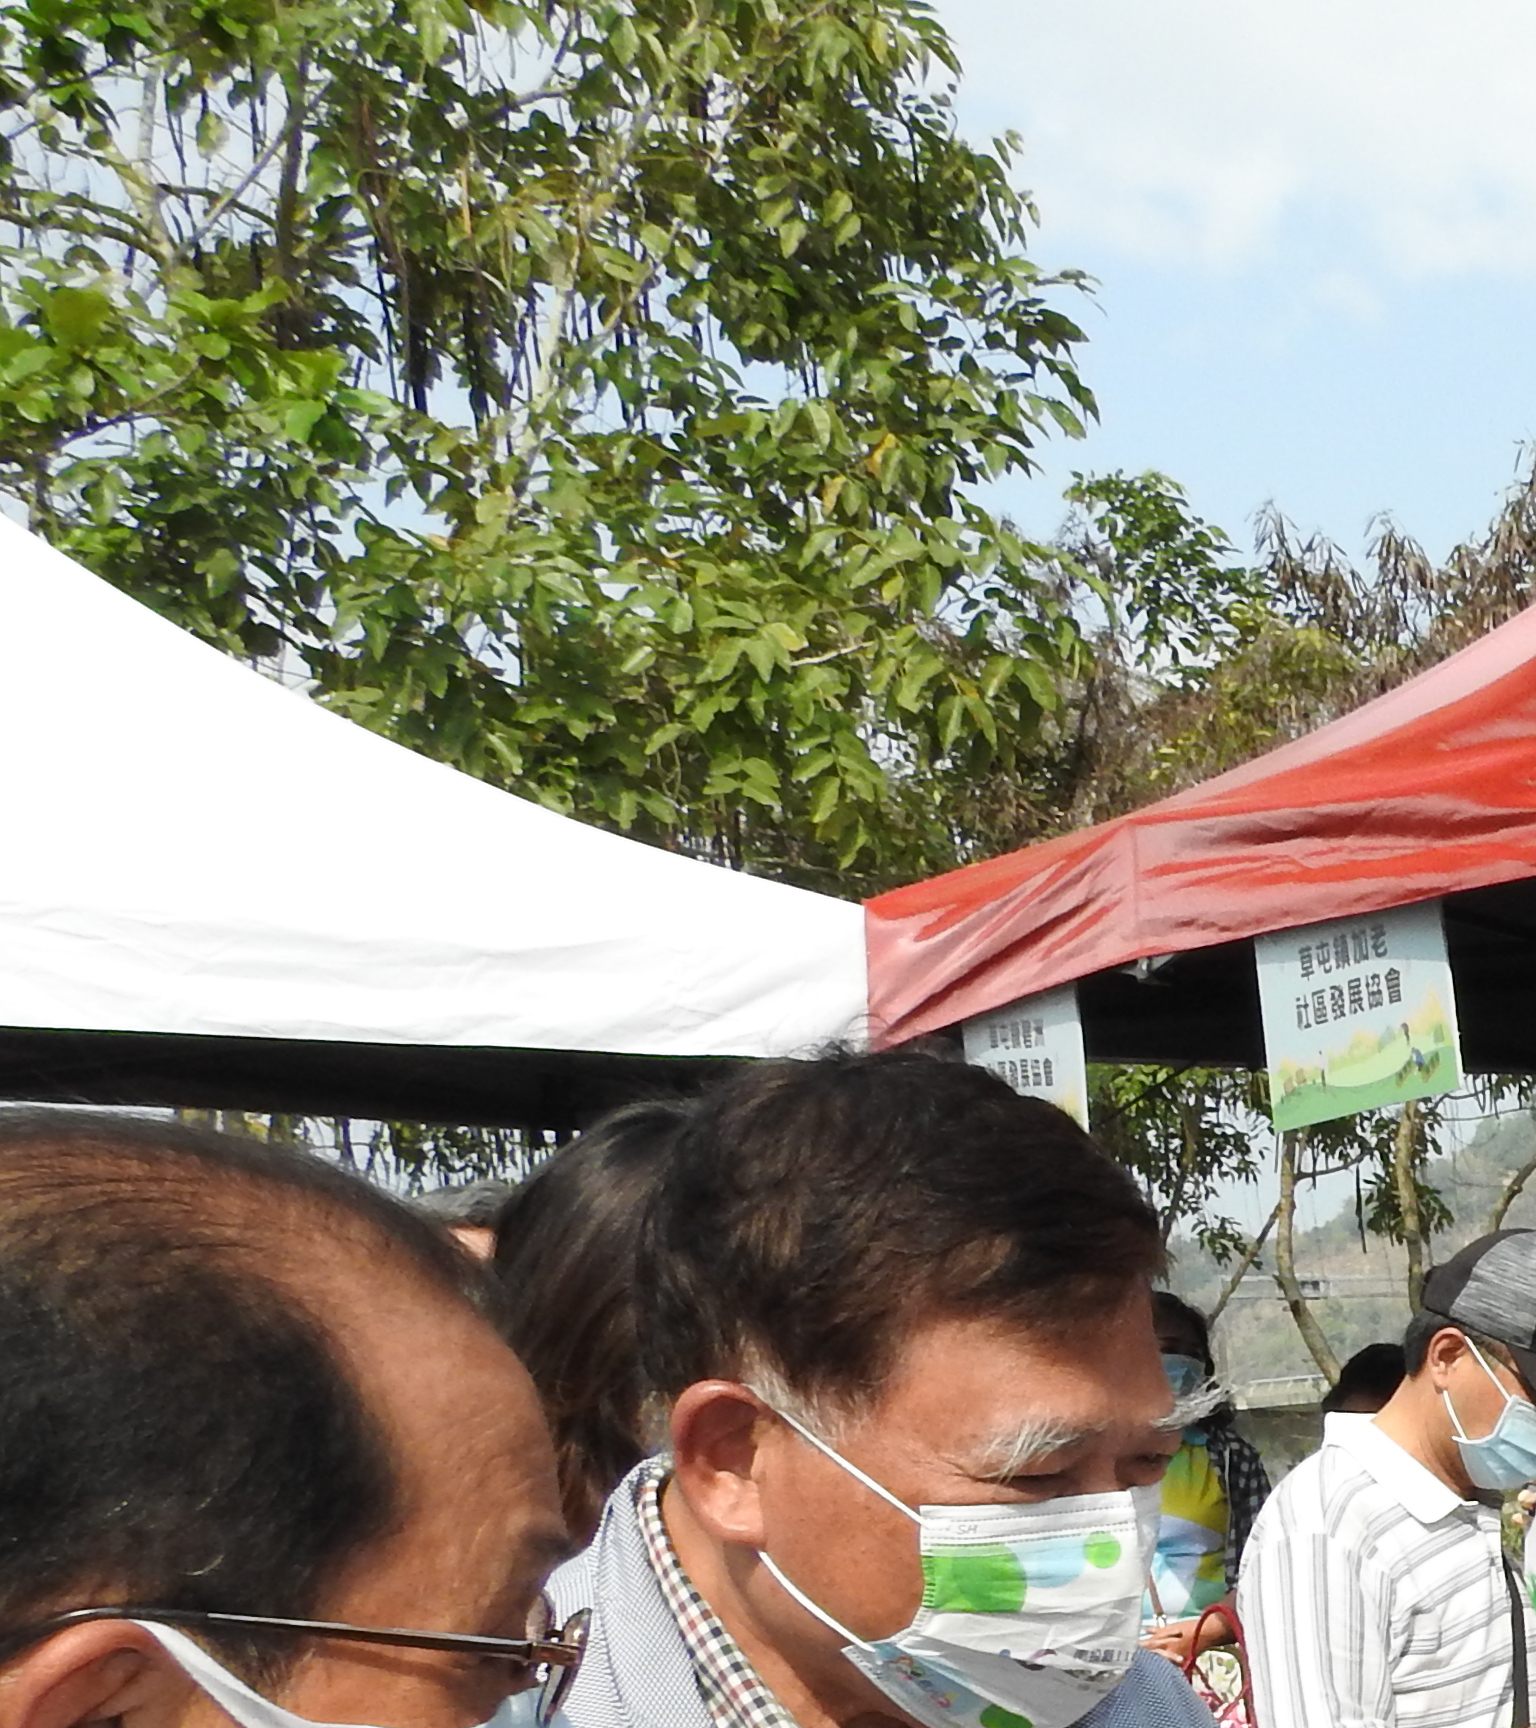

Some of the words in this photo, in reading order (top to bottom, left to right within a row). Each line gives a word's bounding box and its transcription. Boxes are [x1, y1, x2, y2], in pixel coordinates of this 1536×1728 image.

[1296, 966, 1403, 1031] 社區發展協會
